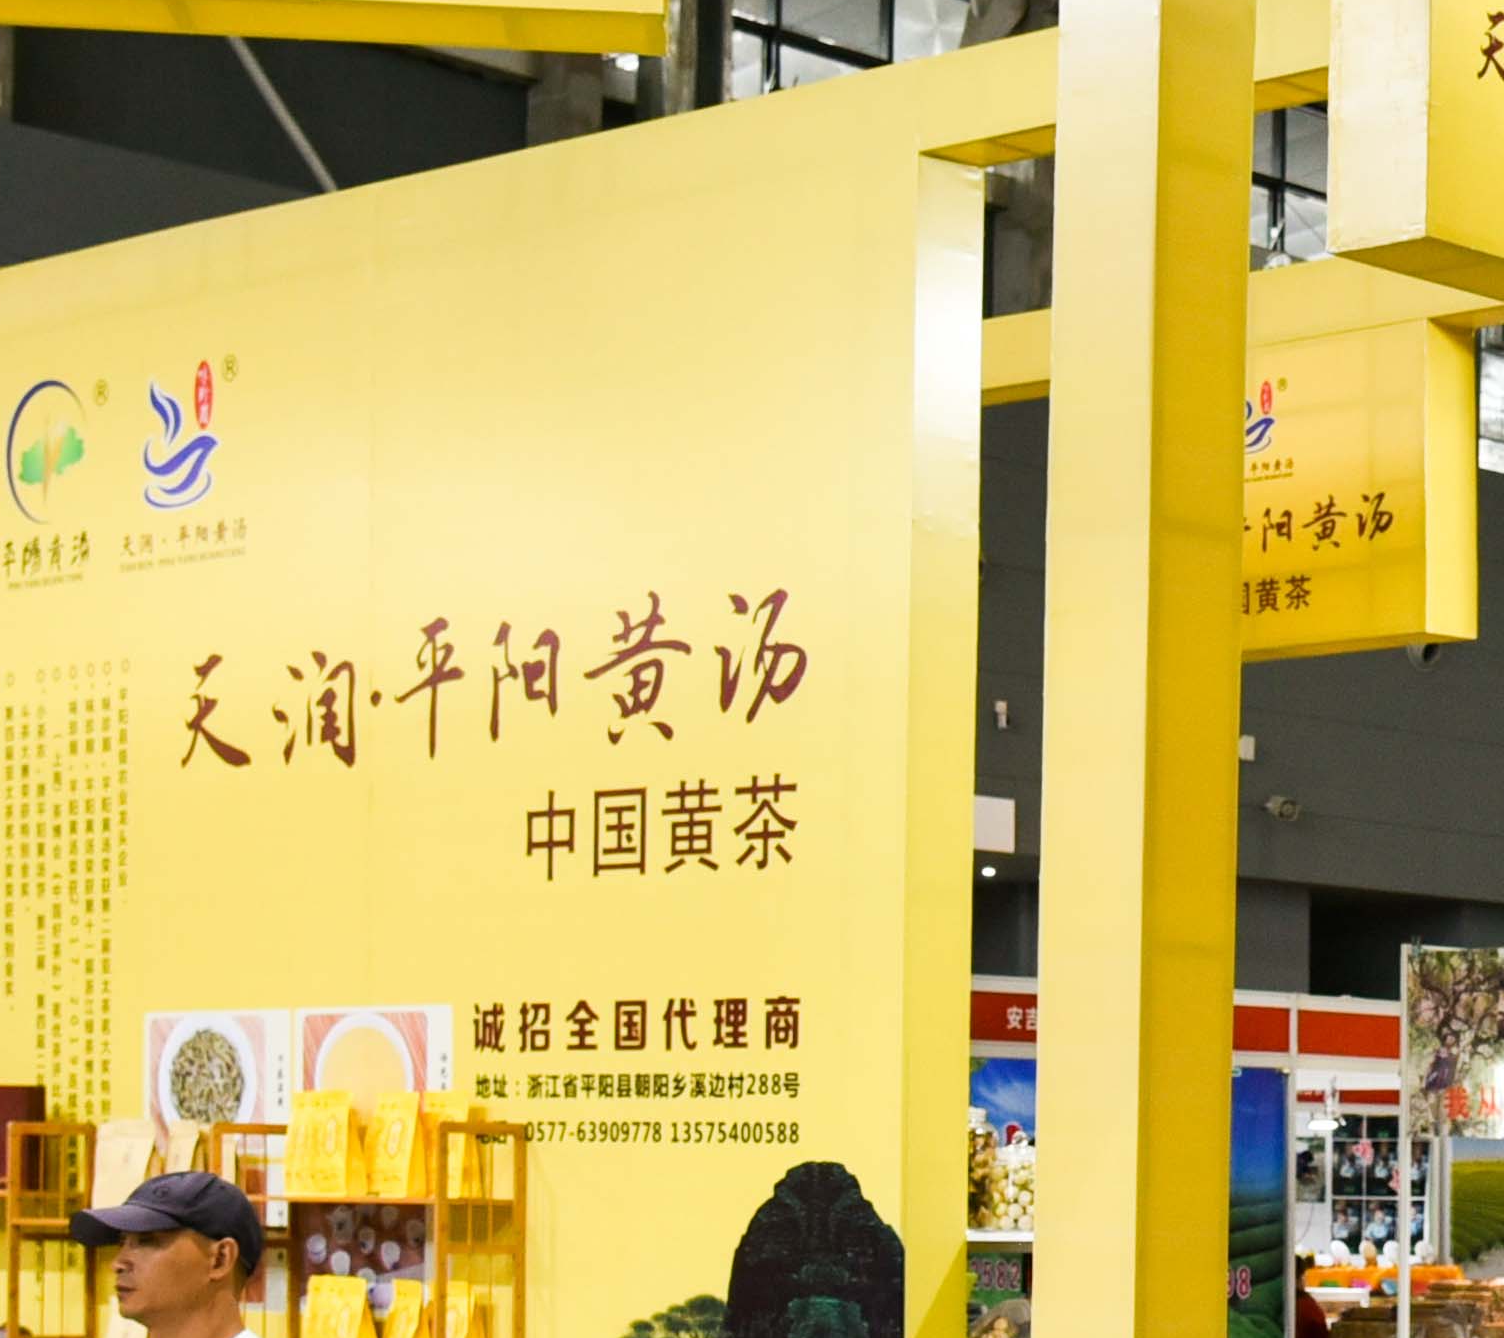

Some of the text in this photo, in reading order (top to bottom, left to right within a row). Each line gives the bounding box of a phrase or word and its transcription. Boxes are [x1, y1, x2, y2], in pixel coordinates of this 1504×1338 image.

[1243, 491, 1394, 554] 阳黄汤
[1243, 573, 1312, 615] 黄茶
[526, 773, 798, 882] 中国黄茶
[473, 995, 801, 1053] 诚招全国代理商
[670, 1120, 801, 1144] 13575400588
